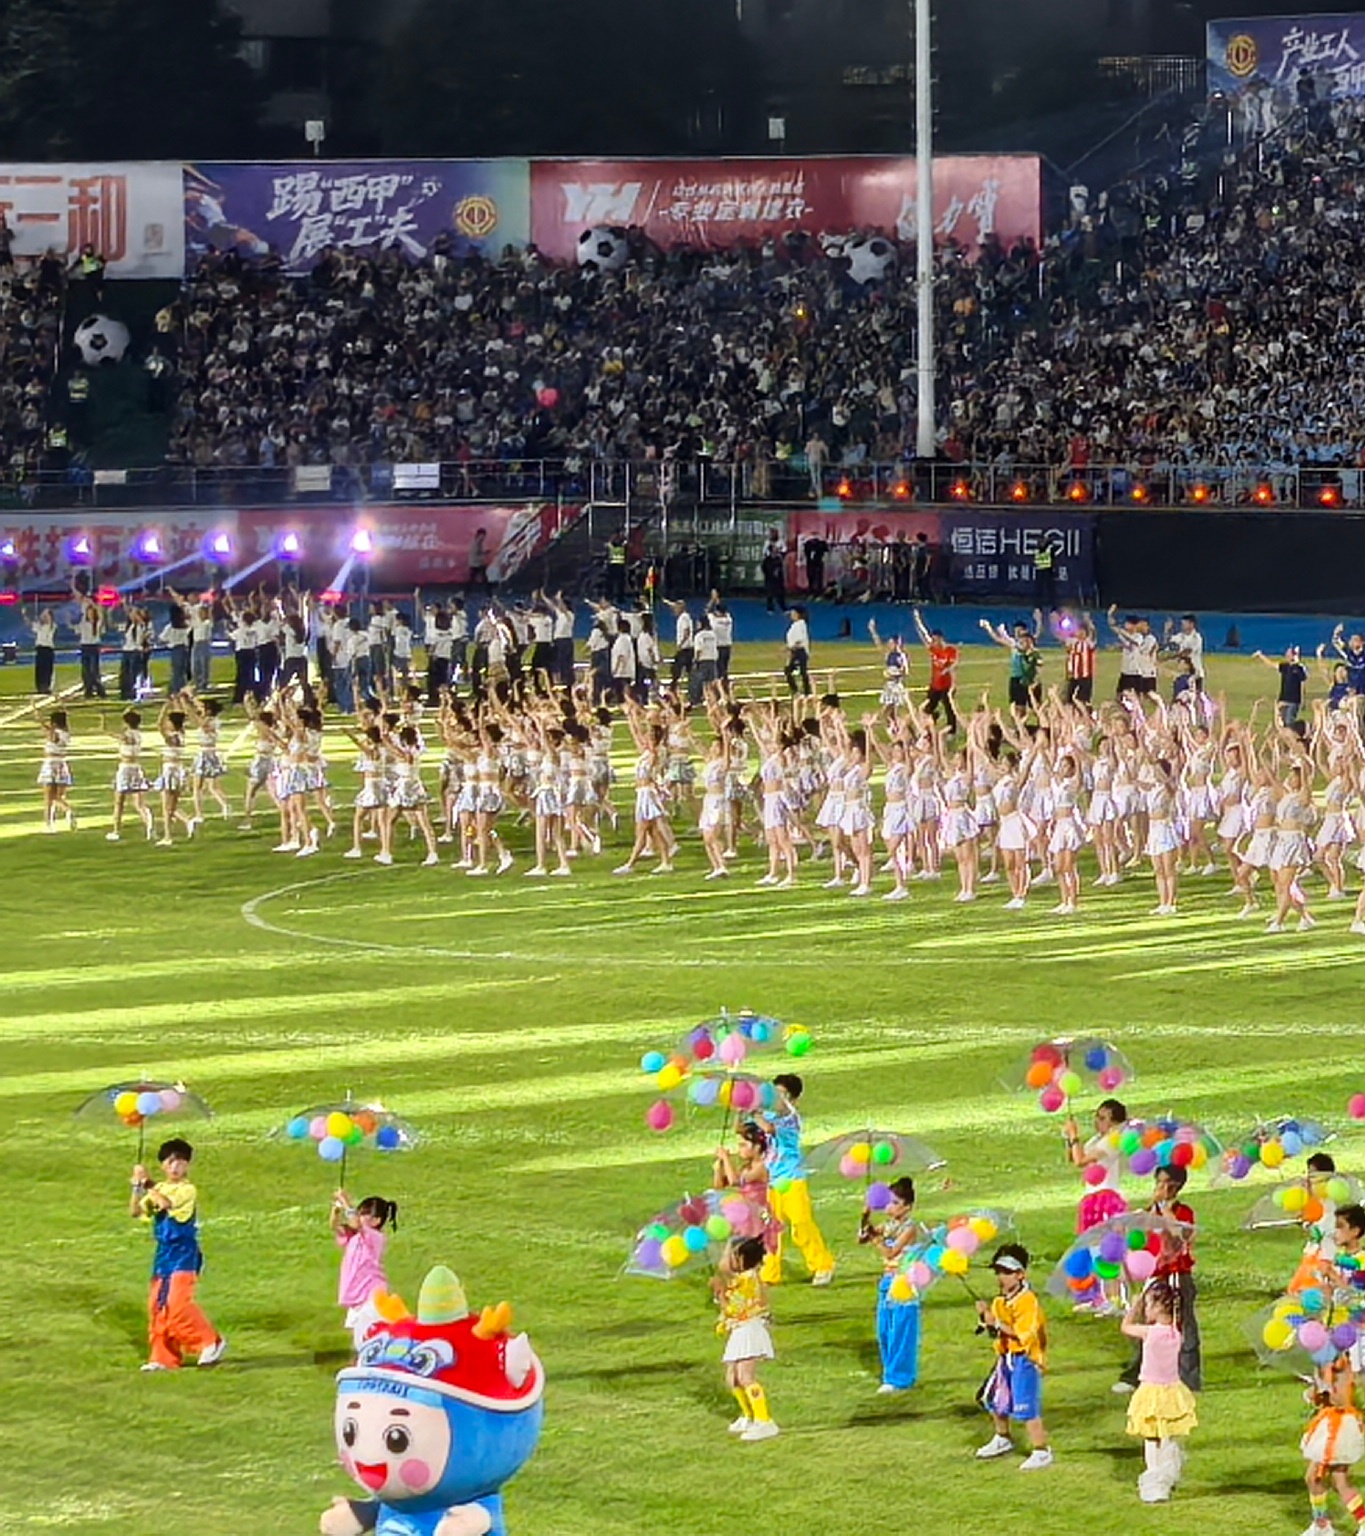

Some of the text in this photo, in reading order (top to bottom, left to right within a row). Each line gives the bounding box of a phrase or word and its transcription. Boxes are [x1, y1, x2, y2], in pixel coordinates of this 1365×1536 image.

[1275, 26, 1359, 80] 产业工人
[266, 171, 414, 221] 踢“西甲”
